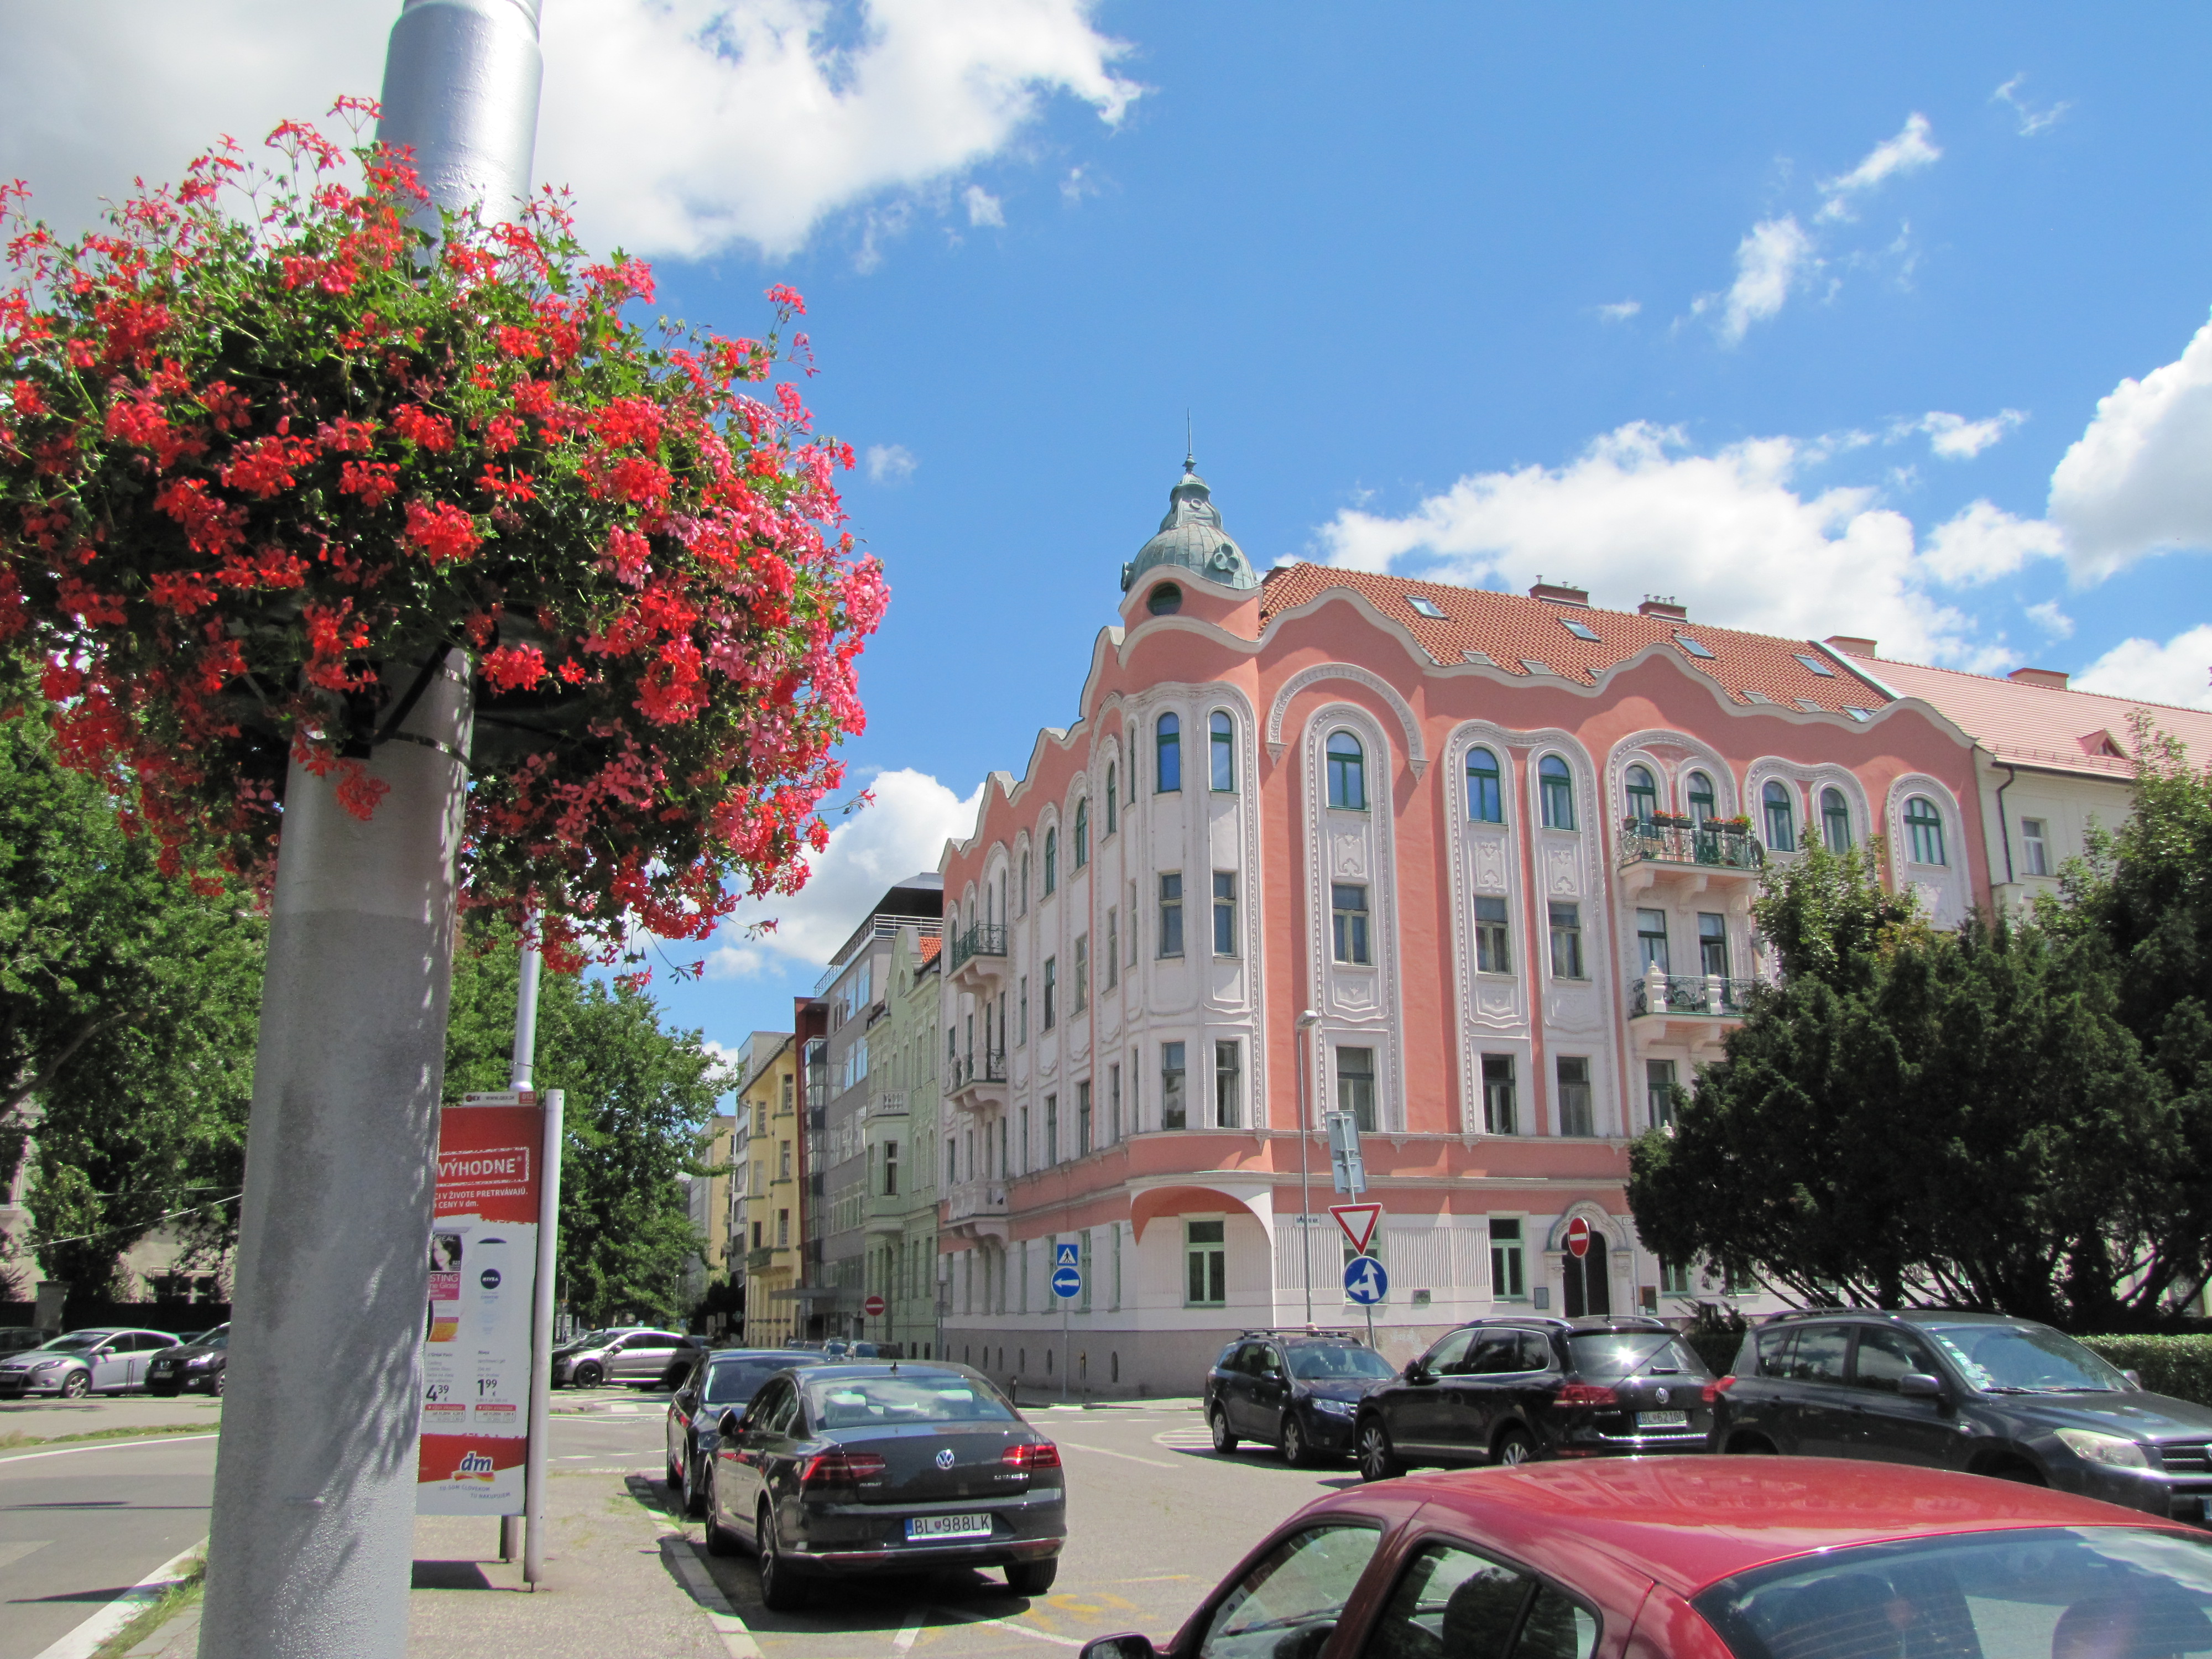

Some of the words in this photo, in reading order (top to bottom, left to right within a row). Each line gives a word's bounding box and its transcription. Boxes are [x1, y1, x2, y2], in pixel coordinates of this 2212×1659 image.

[438, 1157, 515, 1177] VÝHODNE
[449, 1191, 474, 1199] ŽIVOTE
[477, 1186, 528, 1197] PRETRVÁVAJÚ.
[461, 1452, 492, 1472] dm
[915, 1519, 933, 1534] BL
[942, 1515, 990, 1532] 988LK
